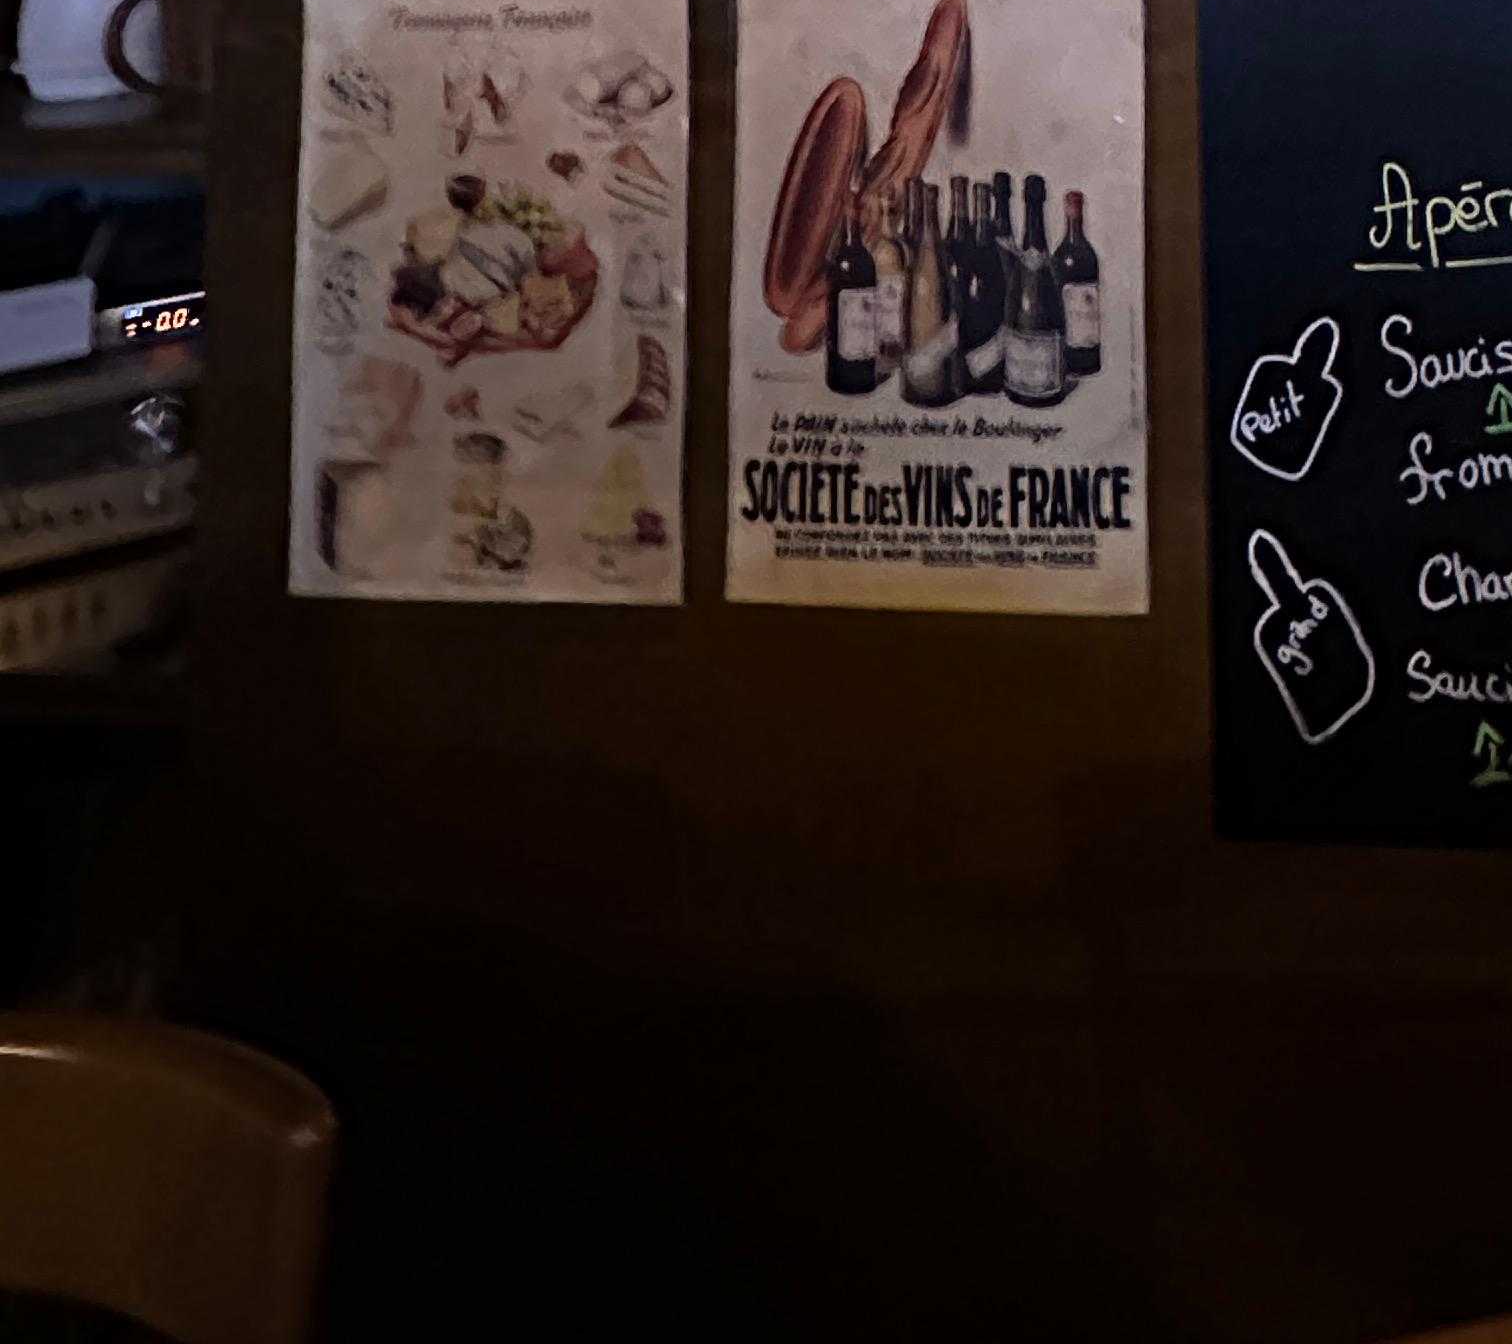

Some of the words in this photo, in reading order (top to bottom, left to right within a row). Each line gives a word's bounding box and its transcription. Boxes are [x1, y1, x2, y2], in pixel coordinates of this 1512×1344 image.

[865, 486, 901, 524] DES
[904, 465, 972, 528] VINS
[977, 488, 1003, 529] DE
[1011, 466, 1131, 529] FRANCE
